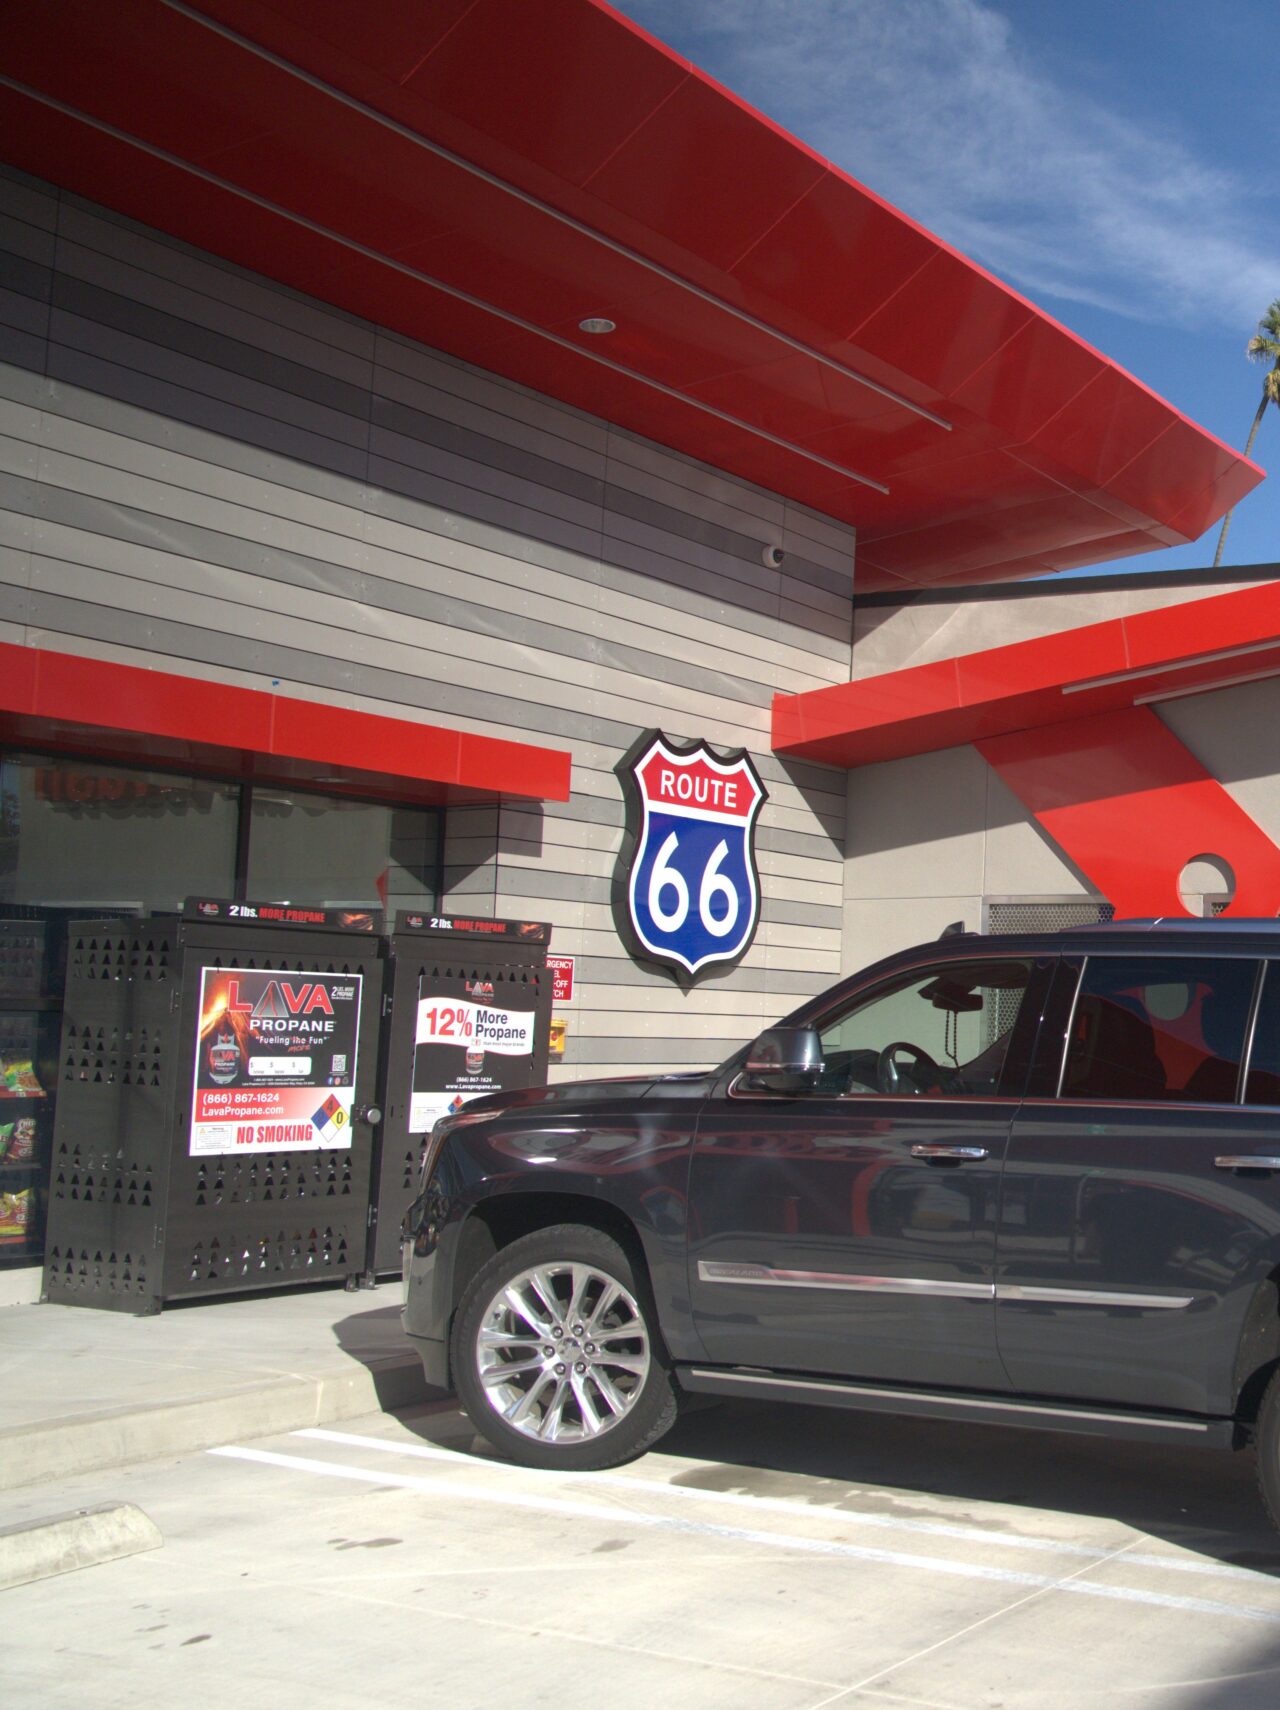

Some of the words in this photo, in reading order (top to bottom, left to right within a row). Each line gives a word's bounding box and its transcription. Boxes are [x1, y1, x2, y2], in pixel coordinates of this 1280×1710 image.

[660, 769, 738, 808] ROUTE
[647, 830, 739, 937] 66
[229, 905, 238, 917] 2
[240, 906, 257, 918] lbs.
[259, 907, 284, 920] MORE
[286, 909, 325, 923] PROPANE
[430, 918, 438, 928] 2
[439, 919, 452, 929] lbs.
[453, 920, 474, 931] MORE
[475, 922, 507, 933] PROPANE
[546, 960, 573, 969] RGENCY
[465, 981, 494, 994] LAVA
[228, 980, 335, 1018] LAVA
[426, 1007, 472, 1037] 12%
[476, 1010, 508, 1025] More
[250, 1020, 335, 1032] PROPANE
[475, 1024, 527, 1041] Propane
[203, 1093, 231, 1105] (866)
[235, 1093, 280, 1104] 867-1624
[202, 1106, 284, 1118] LavaPropane.com
[336, 1112, 343, 1124] 0
[236, 1126, 254, 1144] NO
[256, 1124, 313, 1143] SMOKING
